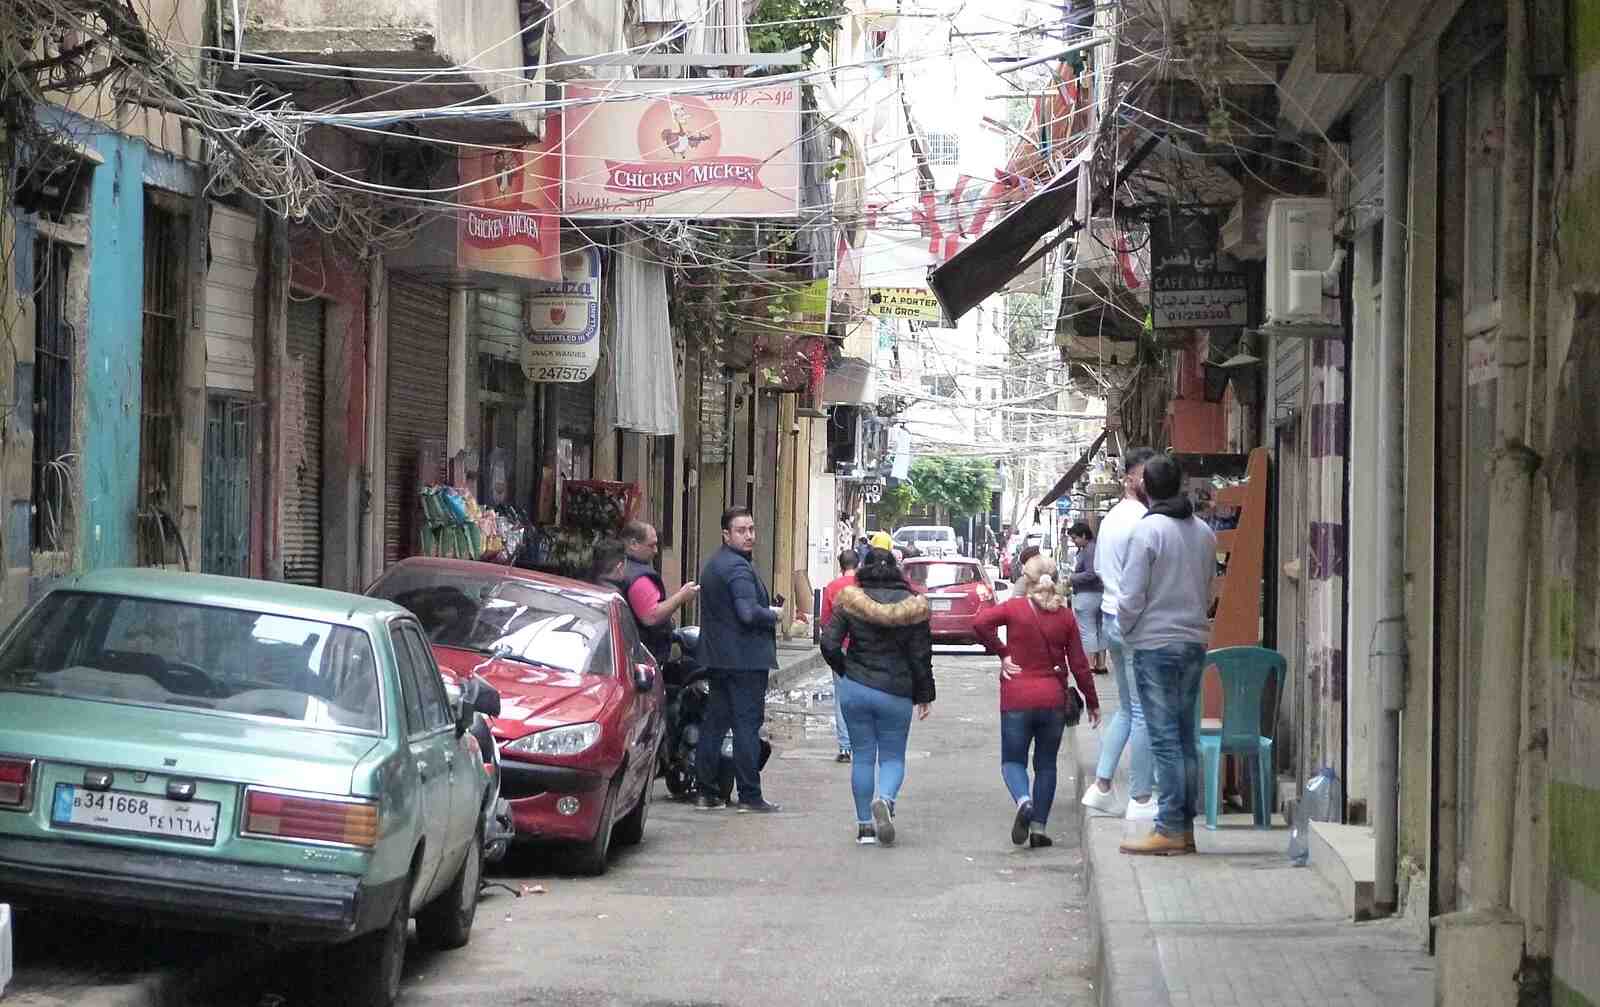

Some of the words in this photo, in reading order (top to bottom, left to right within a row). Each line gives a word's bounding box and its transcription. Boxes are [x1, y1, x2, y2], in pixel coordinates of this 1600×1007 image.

[614, 168, 682, 187] CHICKEN
[688, 162, 754, 183] MICKEN
[468, 212, 505, 240] CHICKEN
[508, 209, 539, 240] MICKEN
[900, 296, 937, 307] PORTER
[879, 306, 892, 314] EN
[894, 306, 921, 317] GROS
[539, 367, 588, 381] 247575
[84, 793, 149, 815] 341668
